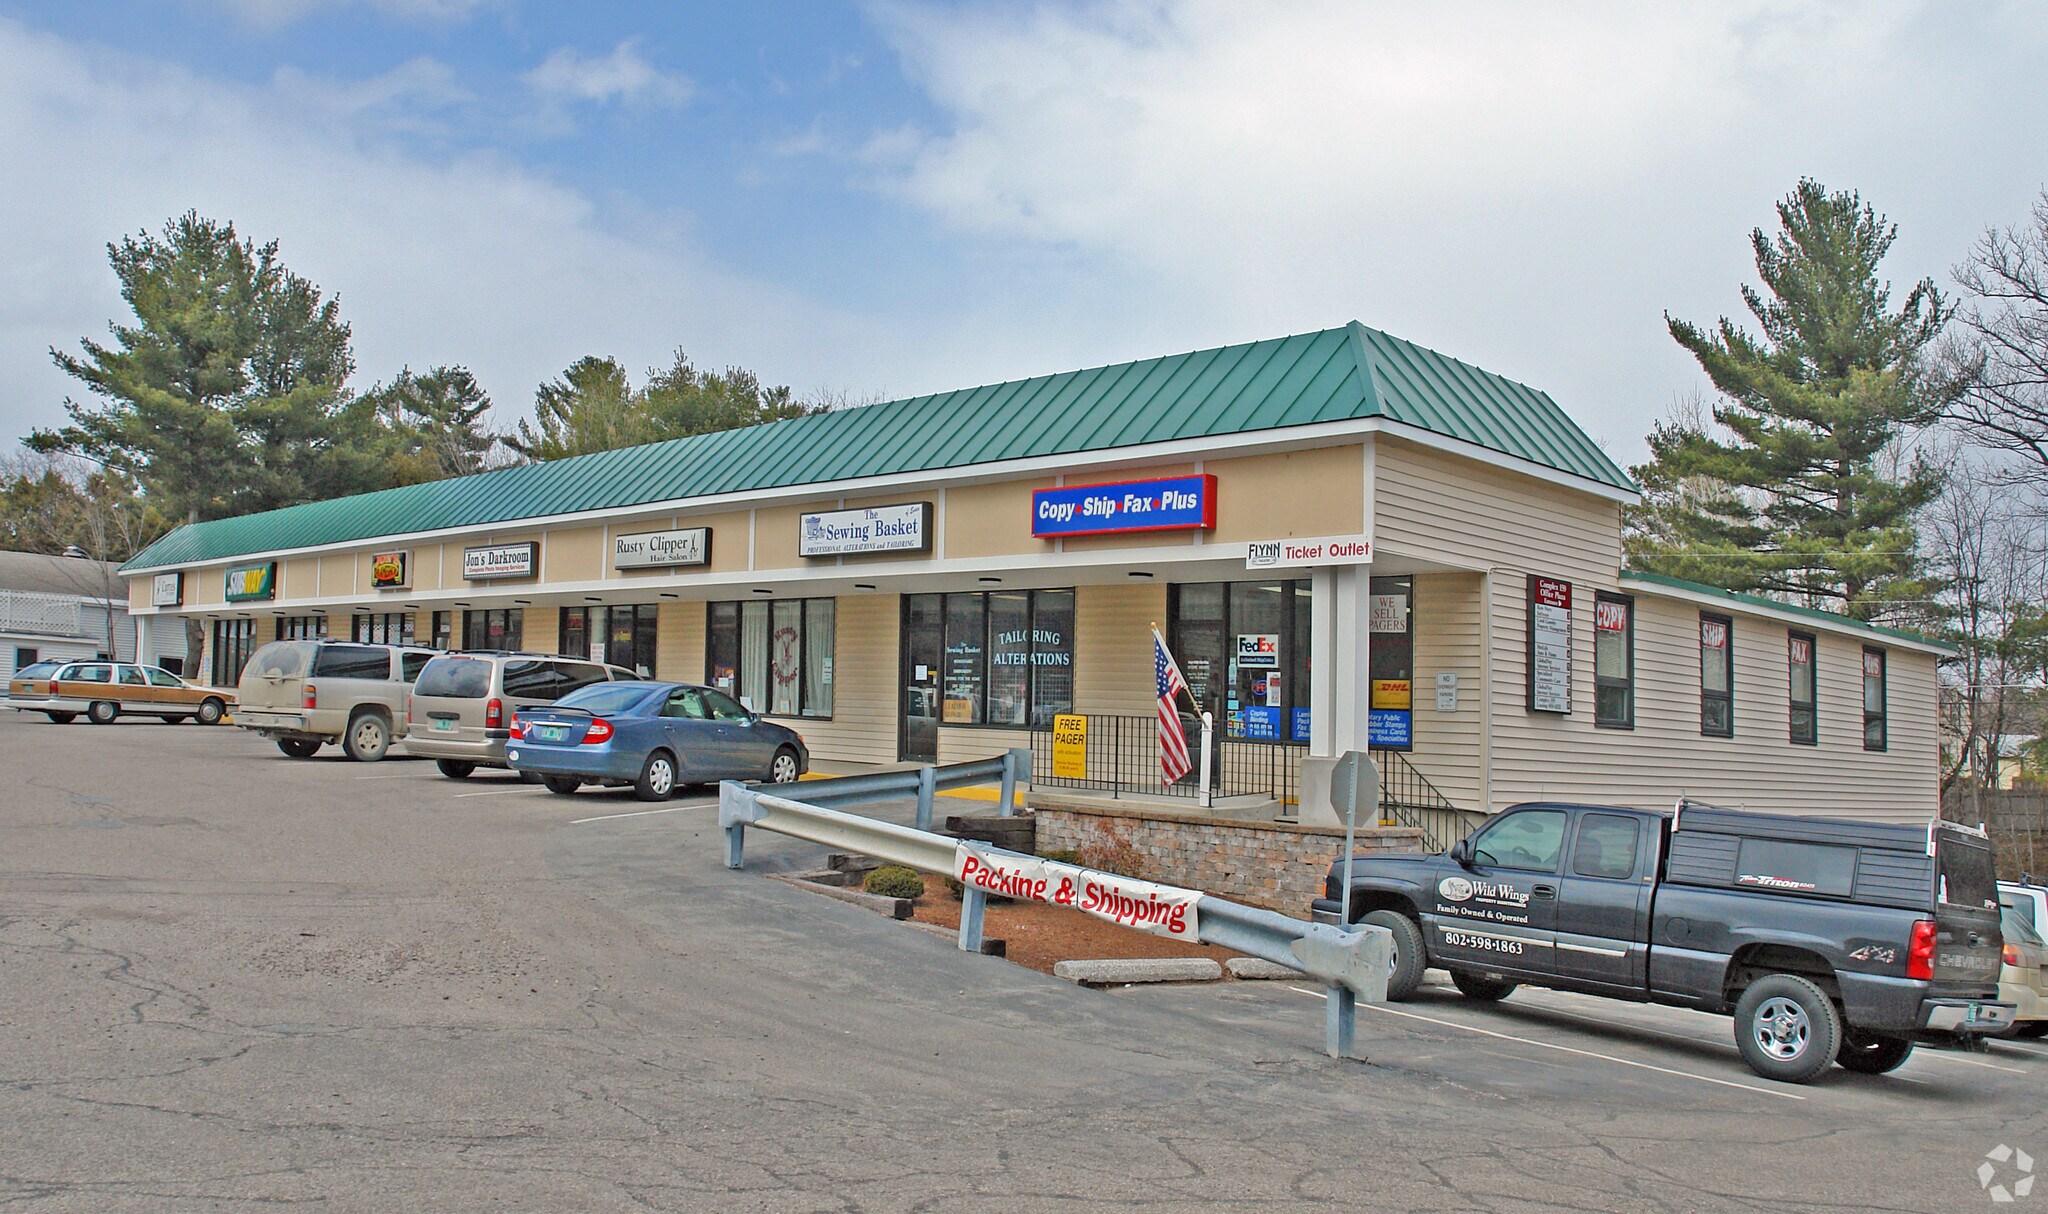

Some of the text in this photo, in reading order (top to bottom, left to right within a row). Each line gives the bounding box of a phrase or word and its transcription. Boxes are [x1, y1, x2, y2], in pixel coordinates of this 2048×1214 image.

[1039, 490, 1197, 522] Copy Ship Fax Plus
[864, 510, 878, 520] The
[826, 518, 918, 541] Sewing Basket
[617, 536, 688, 555] Rusty Clipper
[807, 545, 841, 553] PROFESSIONAL
[843, 543, 875, 551] ALTERATIONS
[886, 540, 914, 548] TAILORING
[1248, 542, 1369, 559] FLYNN Ticket Outlet
[466, 550, 529, 566] Jon's Darkroom
[227, 568, 266, 596] SUBWAY
[1540, 580, 1558, 590] Complex
[1380, 597, 1395, 607] WE
[1540, 589, 1566, 600] Office Plaza
[1374, 609, 1398, 619] SELL
[1597, 603, 1625, 629] COPY
[1369, 620, 1405, 630] PAGERS
[775, 626, 798, 642] Rusty
[1702, 624, 1724, 645] SHIP
[1239, 637, 1275, 652] FedEx
[1792, 641, 1806, 662] FAX
[994, 653, 1070, 666] ALTERATIONS
[1866, 656, 1879, 674] LUS
[772, 662, 798, 687] Clipper
[1059, 719, 1081, 730] FREE
[1055, 733, 1084, 745] PAGER
[1758, 875, 1800, 888] Triton
[962, 856, 1188, 934] Packing & Shipping
[1472, 881, 1530, 903] Wild Wings
[1437, 904, 1459, 915] Family
[1461, 907, 1485, 918] Owned
[1496, 912, 1528, 924] Operated
[1939, 953, 1997, 969] CHEVROLET
